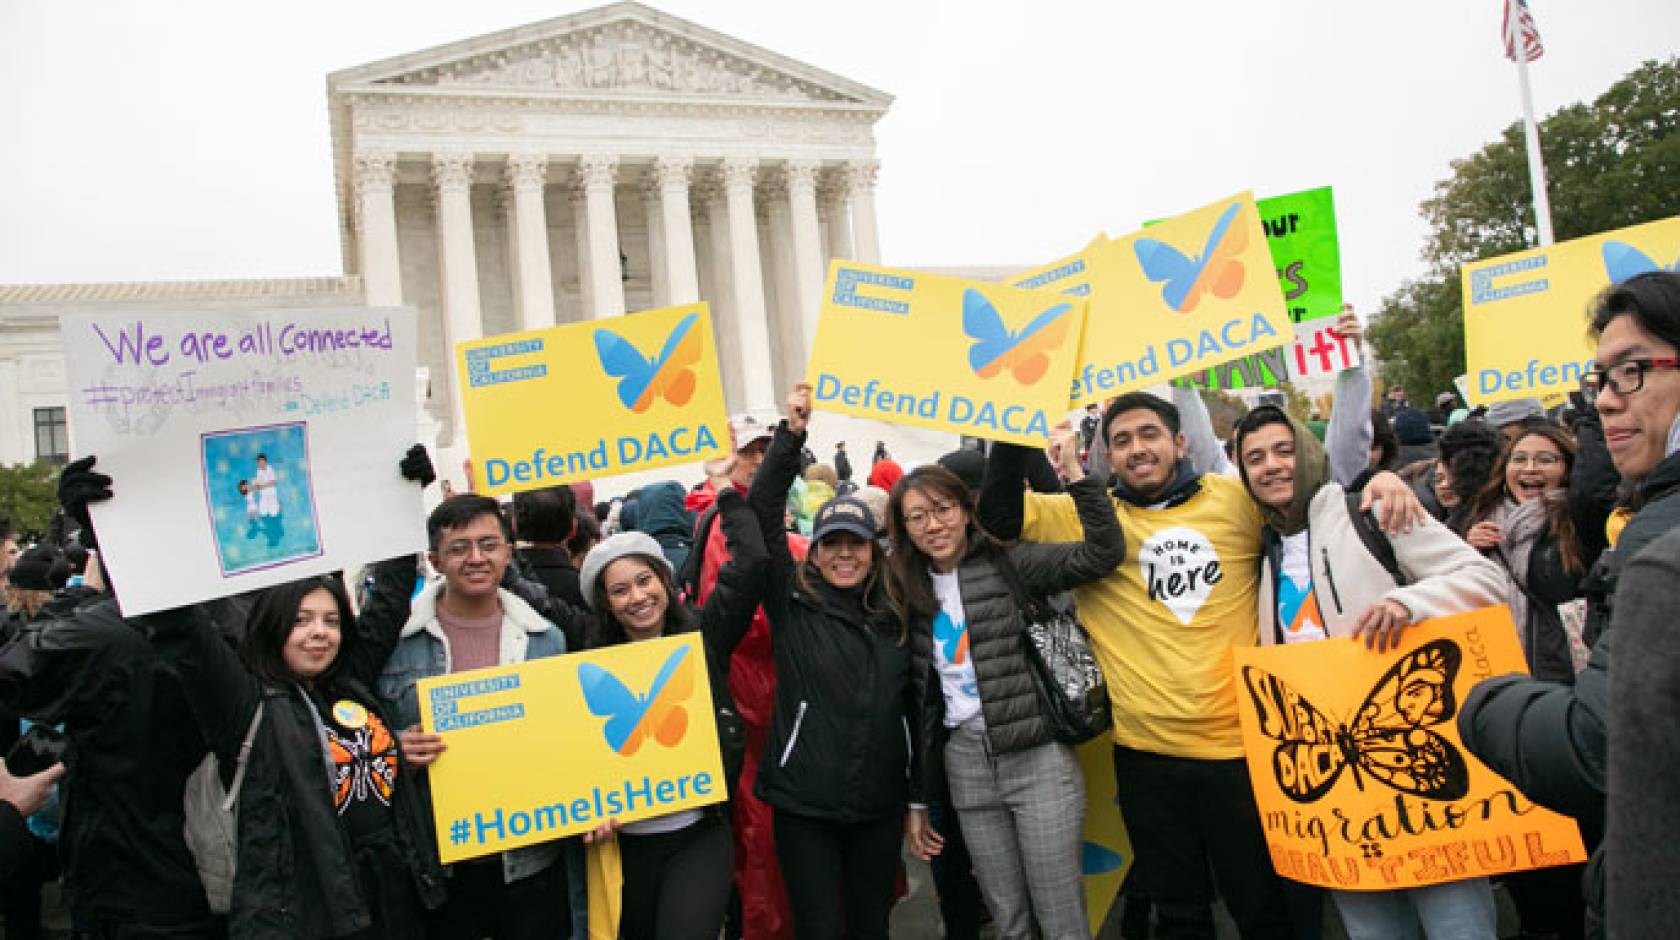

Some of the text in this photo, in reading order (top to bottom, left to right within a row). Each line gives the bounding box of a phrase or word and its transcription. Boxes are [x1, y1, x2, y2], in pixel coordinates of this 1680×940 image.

[92, 319, 393, 366] We are all Connected
[1069, 346, 1160, 400] efend
[1166, 312, 1277, 369] DACA
[815, 373, 1050, 438] Defend DACA
[485, 423, 719, 487] Defend DACA
[1146, 560, 1224, 601] here
[449, 770, 713, 847] #HomeIsHere
[1266, 790, 1536, 858] migration
